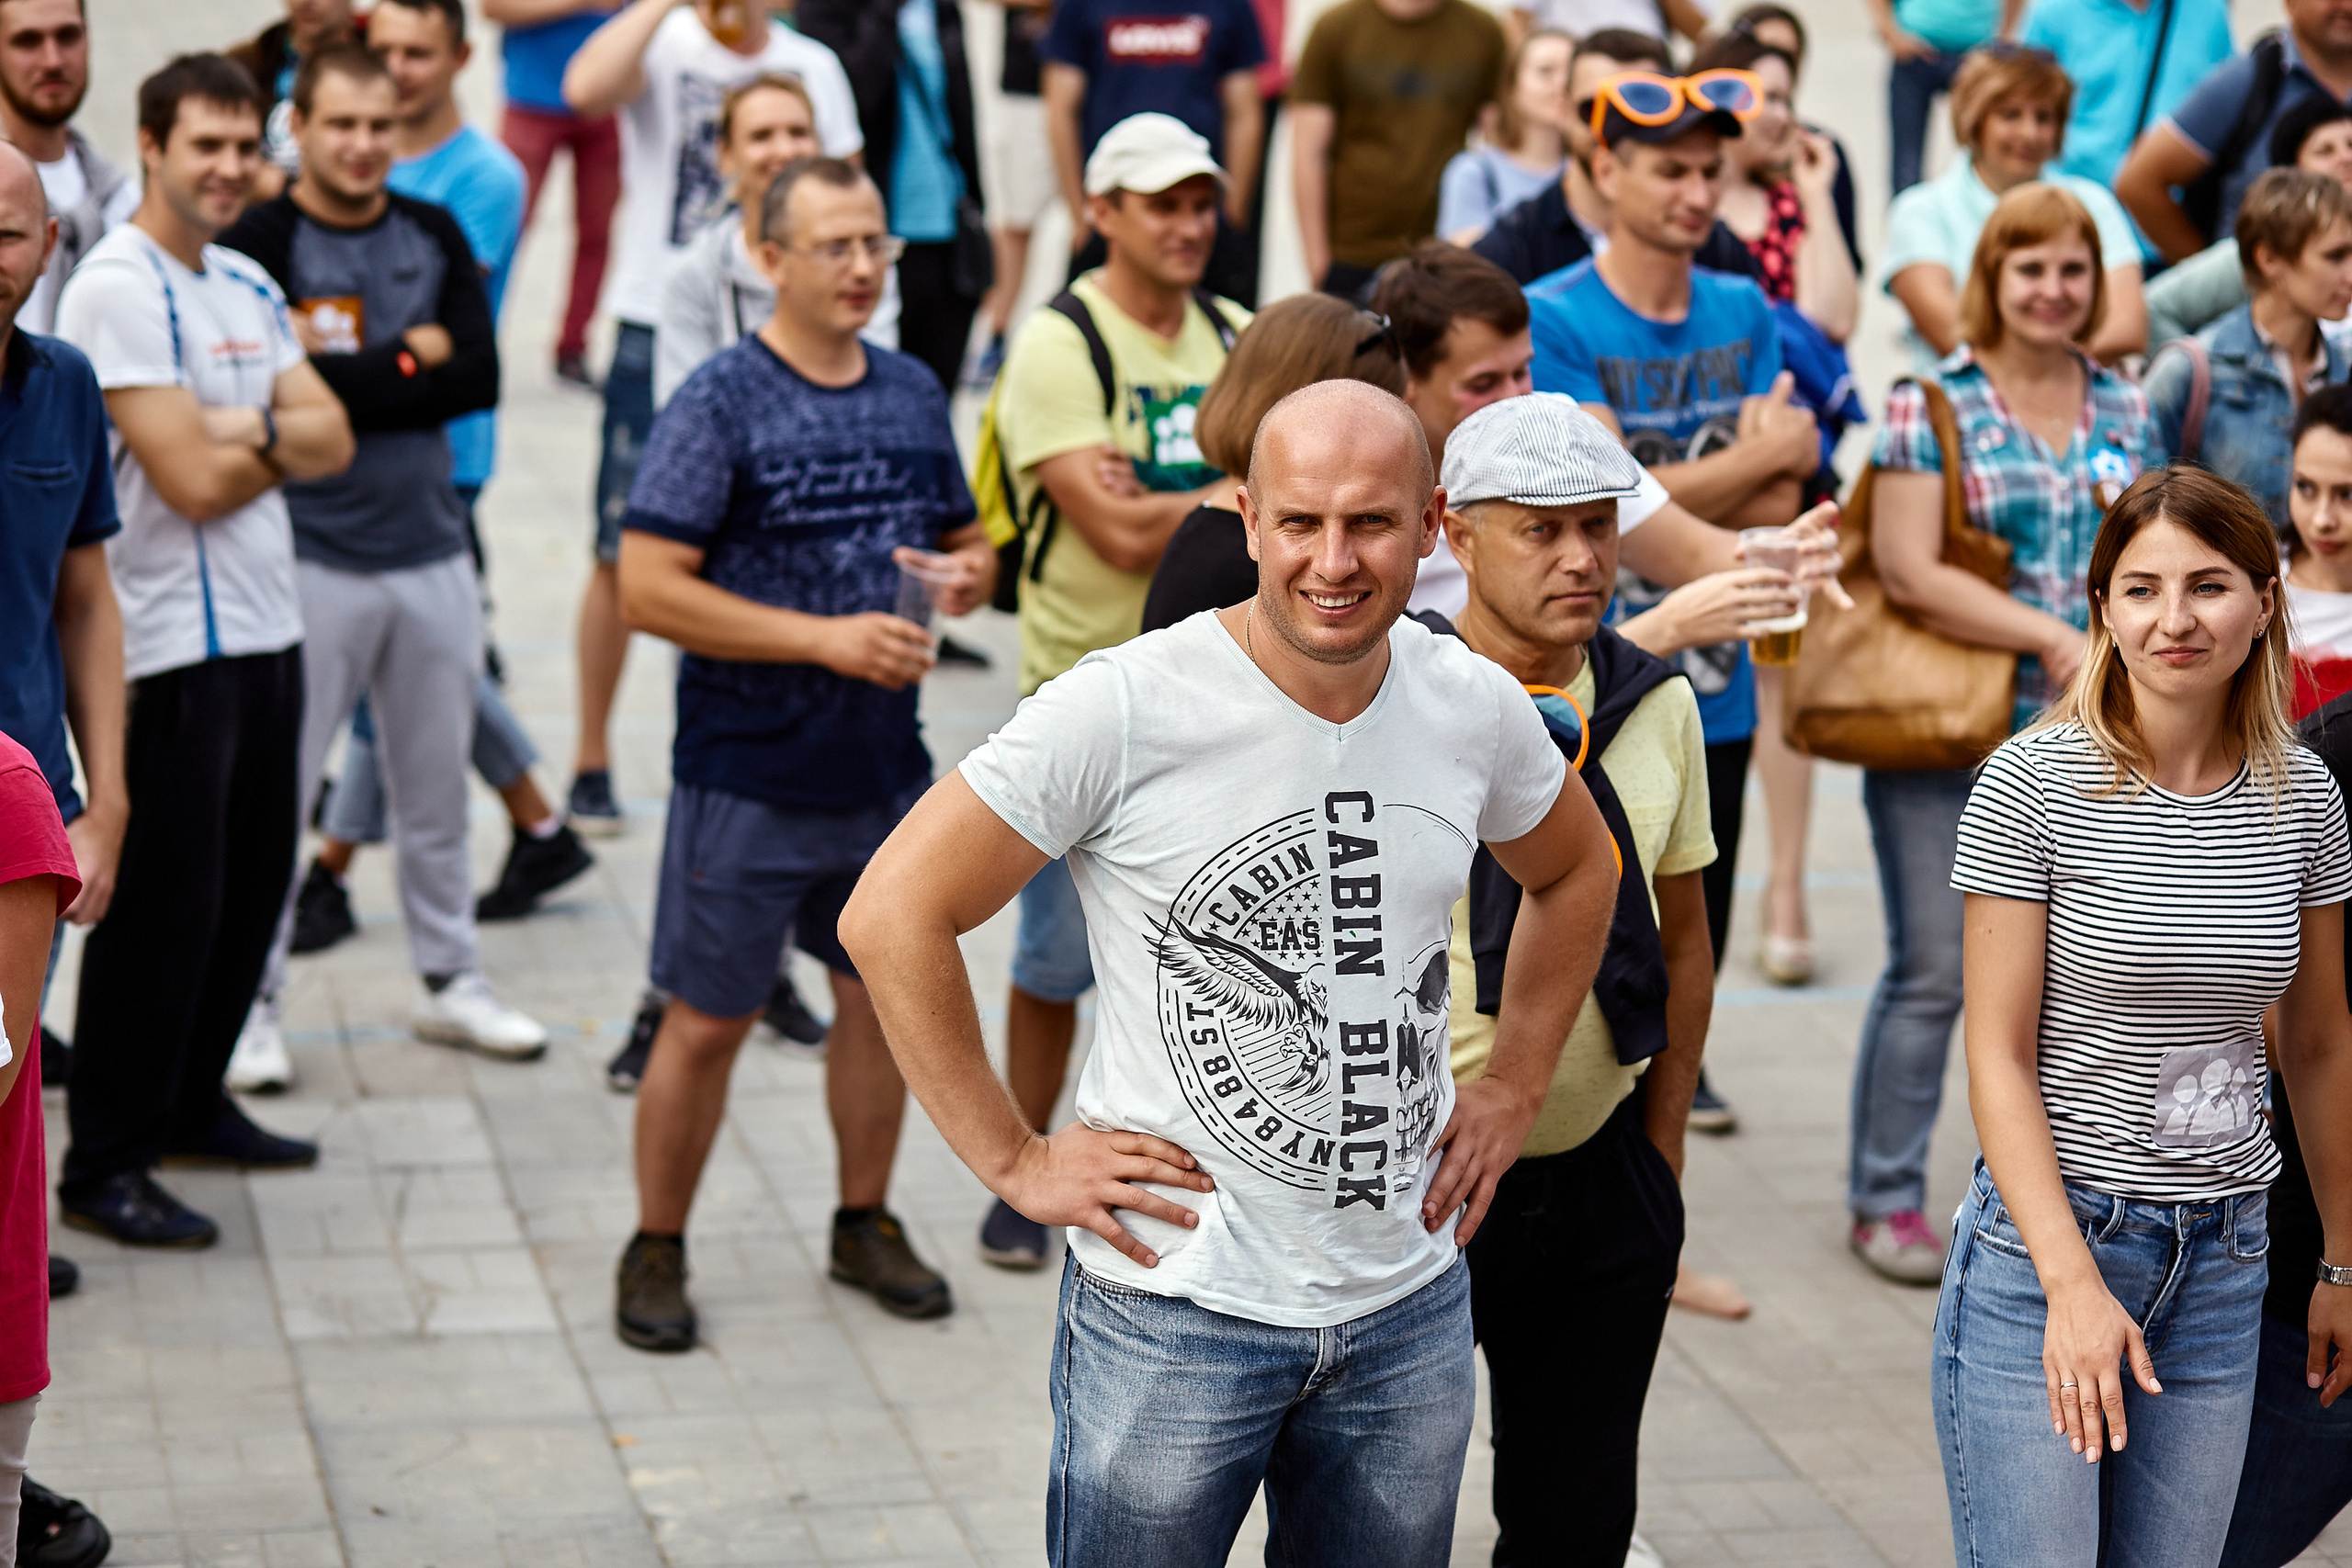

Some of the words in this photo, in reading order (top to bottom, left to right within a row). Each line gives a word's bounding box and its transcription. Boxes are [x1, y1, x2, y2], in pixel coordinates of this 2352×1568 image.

[1208, 842, 1316, 926] CABIN
[1259, 919, 1321, 952] EAS
[1324, 790, 1385, 977] CABIN
[1333, 1018, 1390, 1212] BLACK
